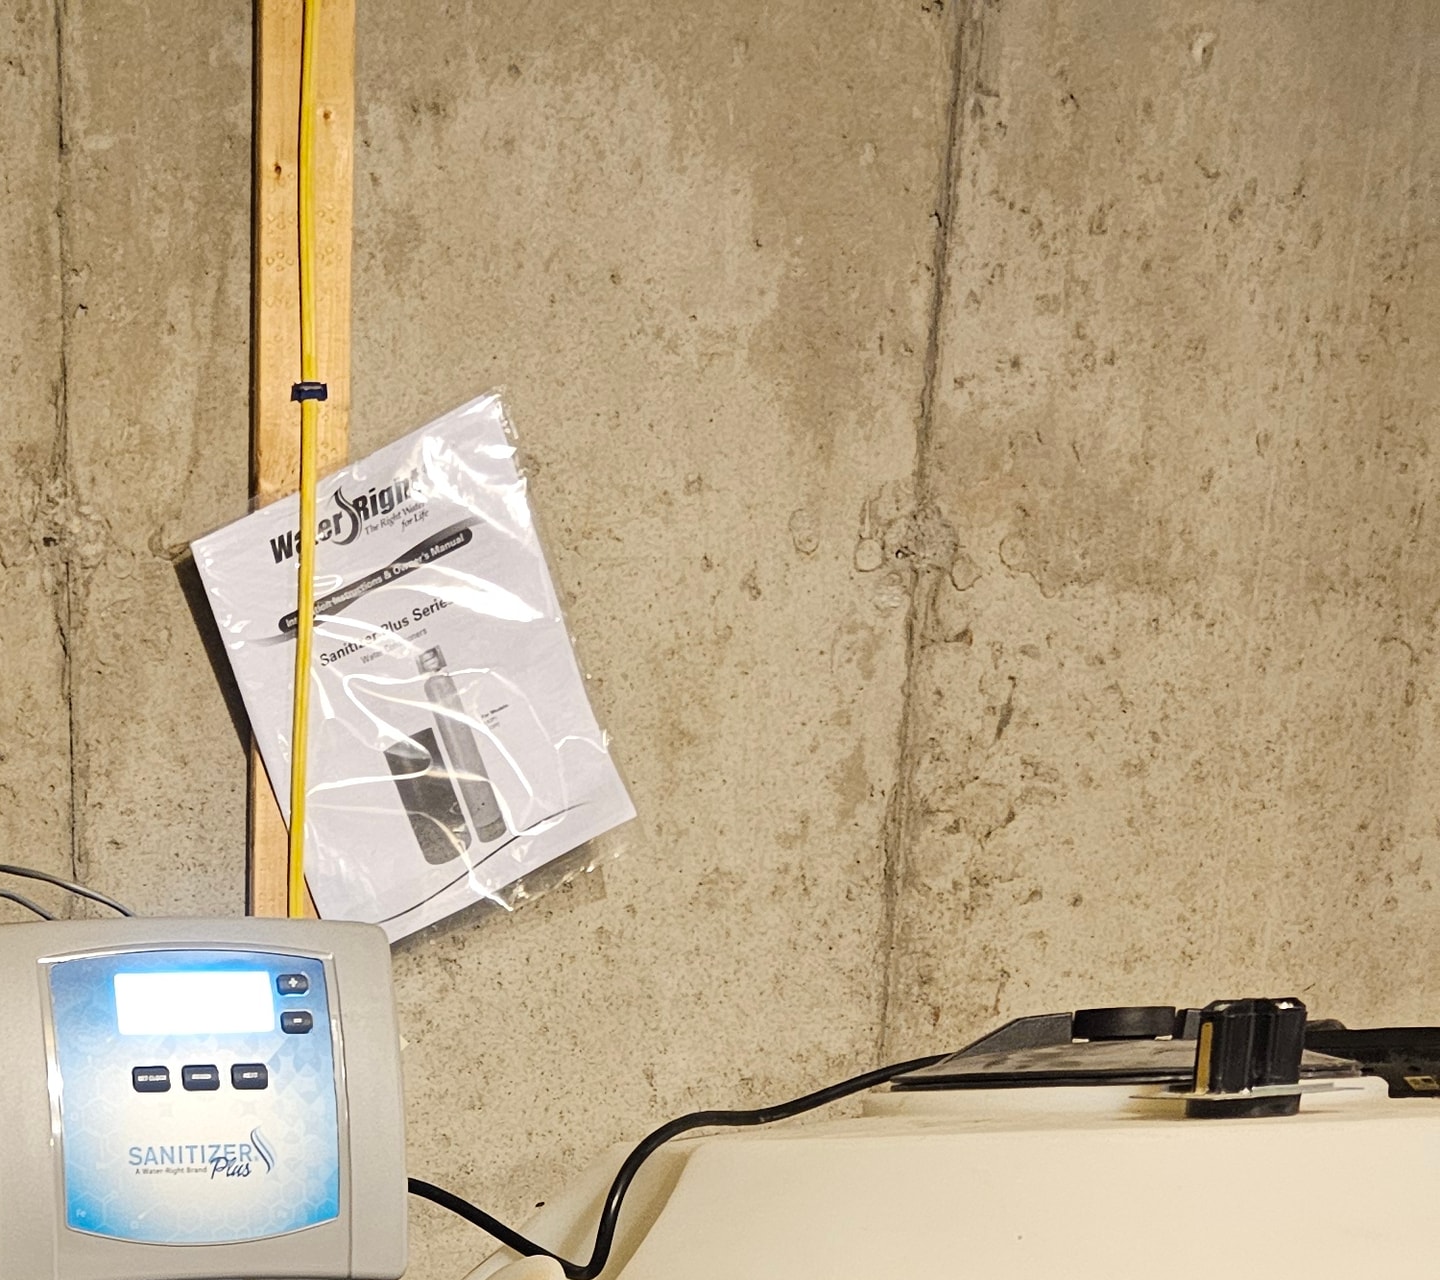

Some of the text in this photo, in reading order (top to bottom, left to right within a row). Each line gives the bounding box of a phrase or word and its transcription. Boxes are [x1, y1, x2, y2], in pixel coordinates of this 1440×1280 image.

[364, 523, 378, 535] The
[380, 510, 401, 531] Right
[414, 509, 429, 526] Life
[430, 533, 465, 558] Manual
[413, 598, 454, 622] Serie
[129, 1143, 252, 1166] SANITIZER
[210, 1156, 252, 1179] Plus
